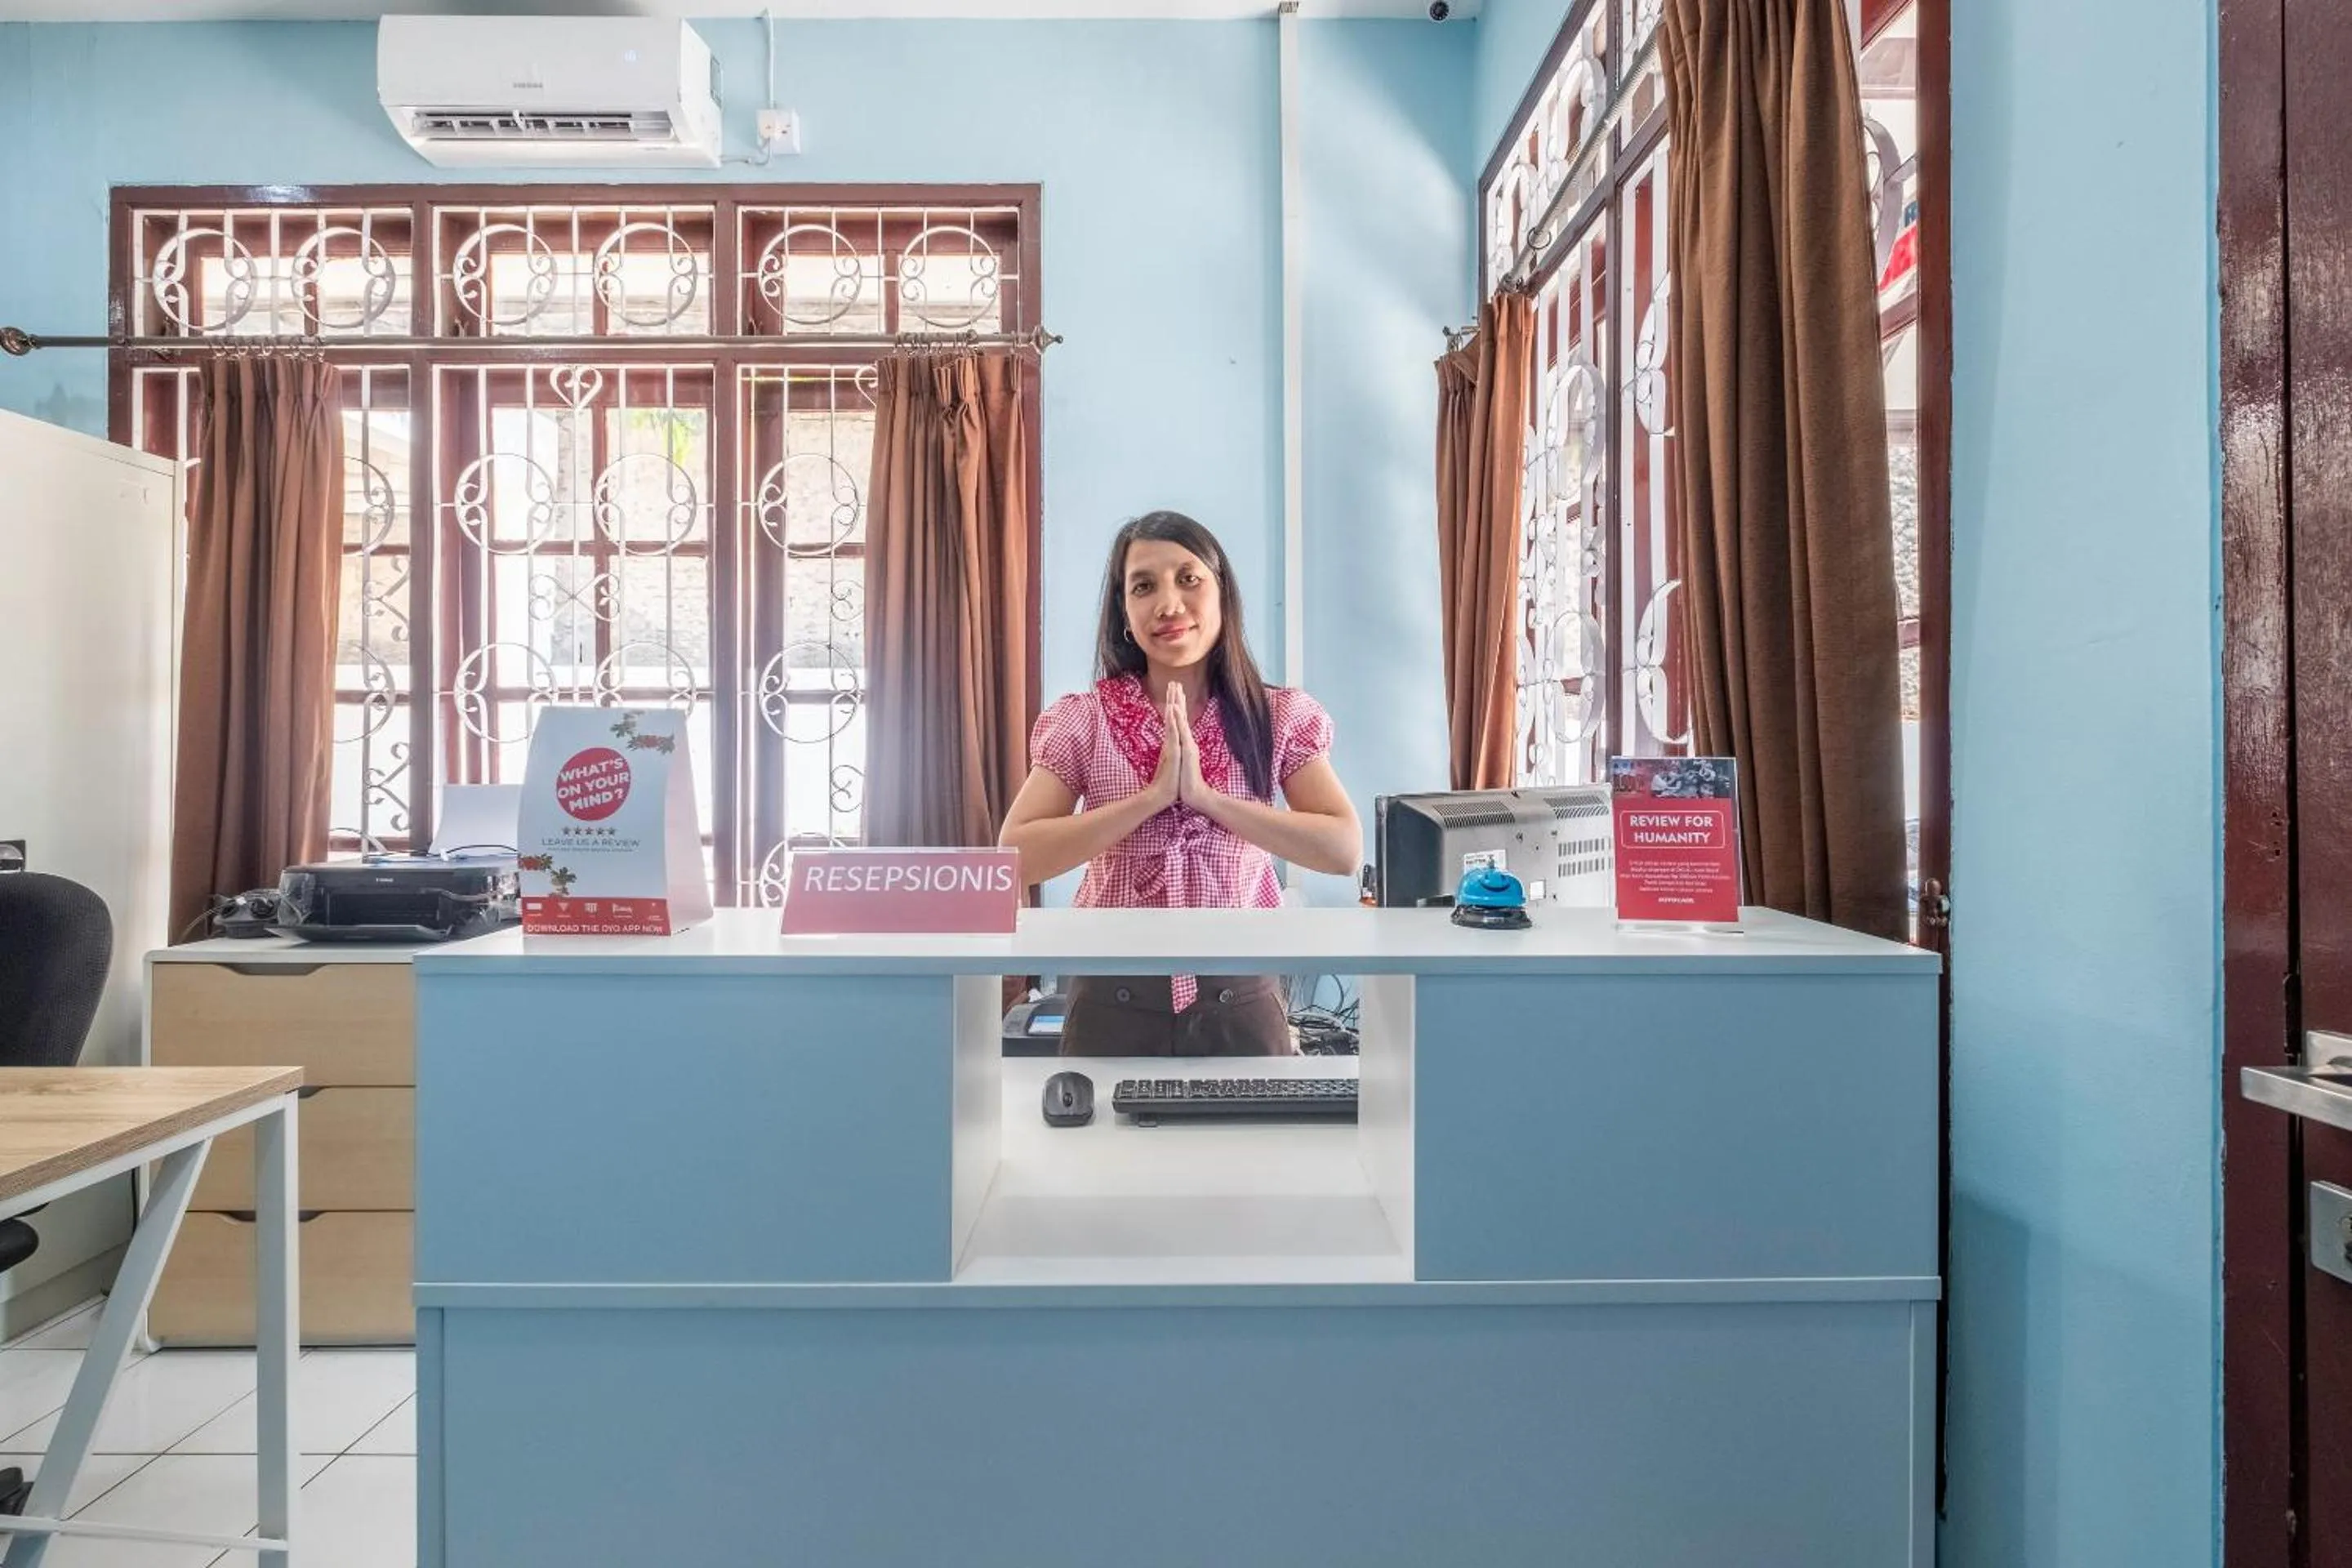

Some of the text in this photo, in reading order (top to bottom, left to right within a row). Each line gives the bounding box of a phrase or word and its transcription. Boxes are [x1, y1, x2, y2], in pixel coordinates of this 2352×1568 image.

[560, 758, 624, 782] WHAT'S
[558, 772, 629, 798] ON YOUR
[1630, 815, 1713, 827] REVIEW FOR
[1634, 831, 1711, 844] HUMANITY
[804, 865, 1013, 892] RESEPSIONIS
[527, 924, 579, 933] DOWNLOAD
[582, 924, 600, 933] THE
[622, 924, 640, 933] APP
